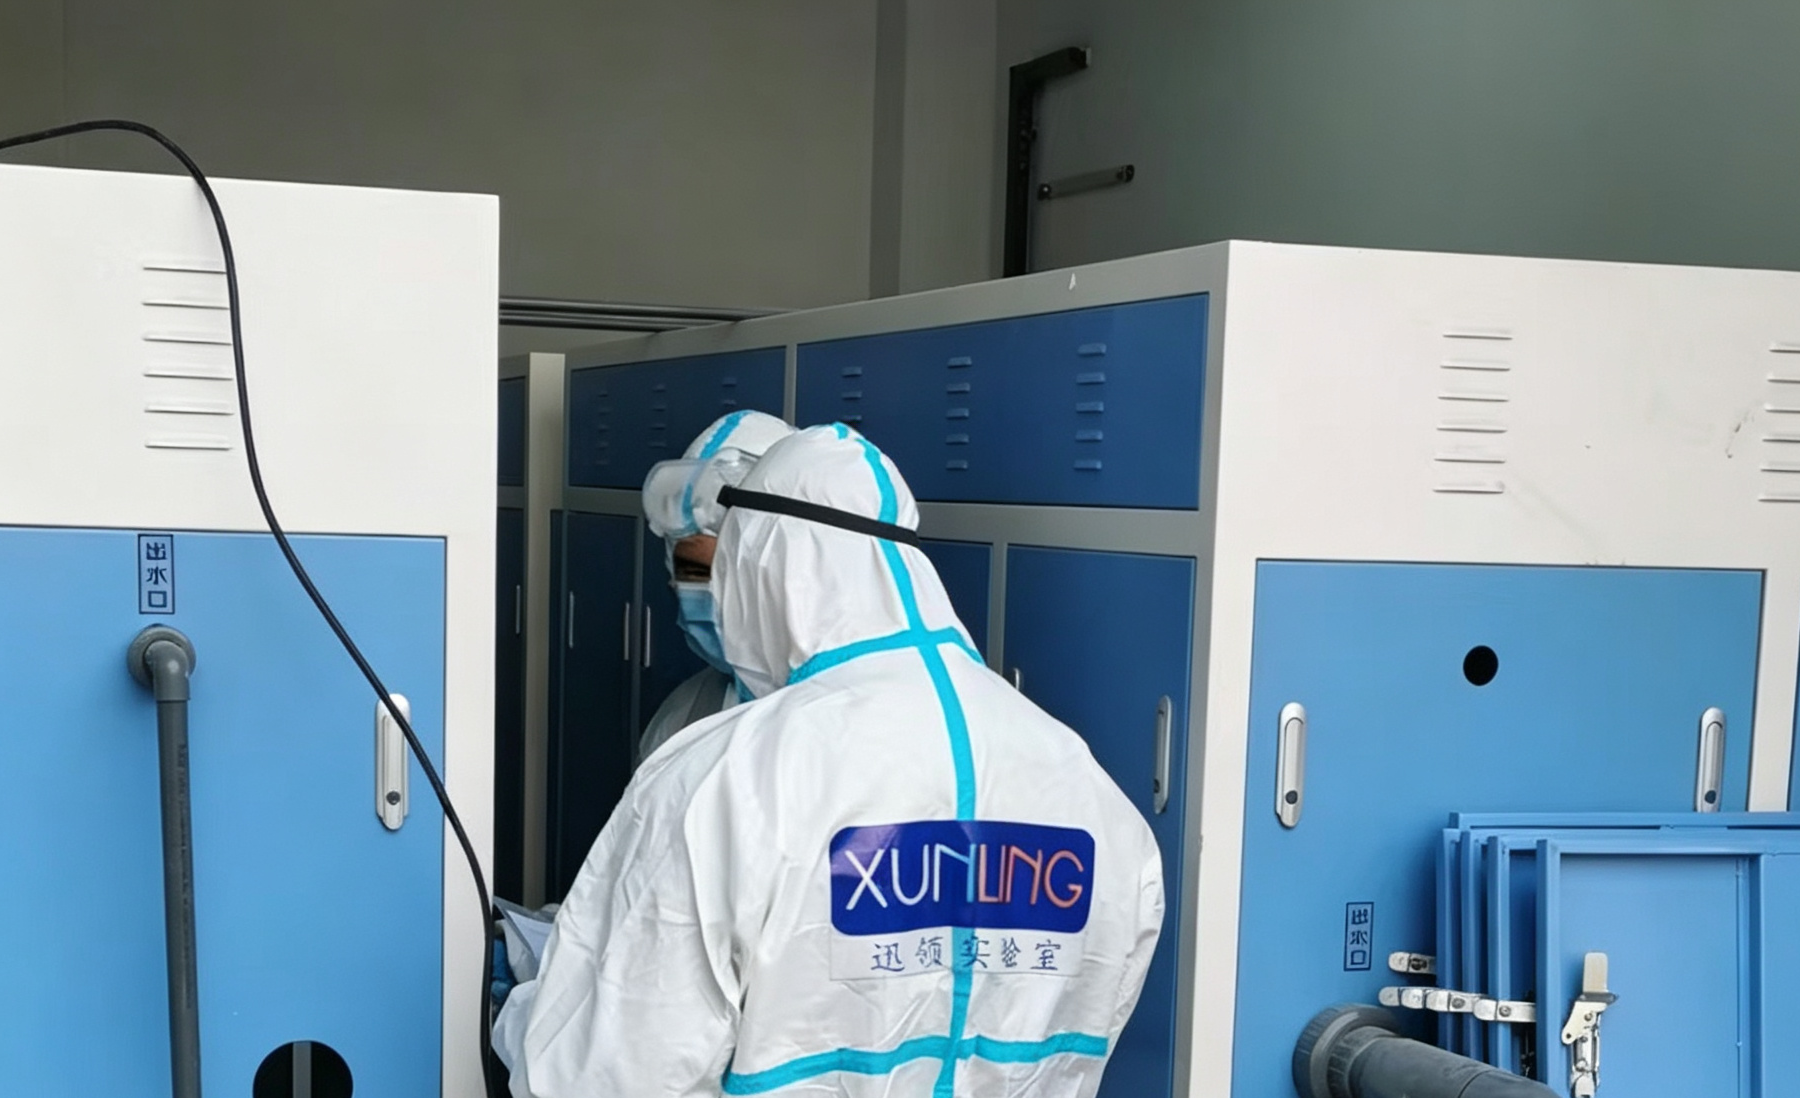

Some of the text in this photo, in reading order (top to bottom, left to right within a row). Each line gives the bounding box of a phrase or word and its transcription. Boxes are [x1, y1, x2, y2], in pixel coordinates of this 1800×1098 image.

[145, 541, 168, 609] 出水口
[845, 843, 1084, 911] XUNLING
[870, 936, 1062, 972] 迅领实验室
[1349, 908, 1369, 966] 出水口
